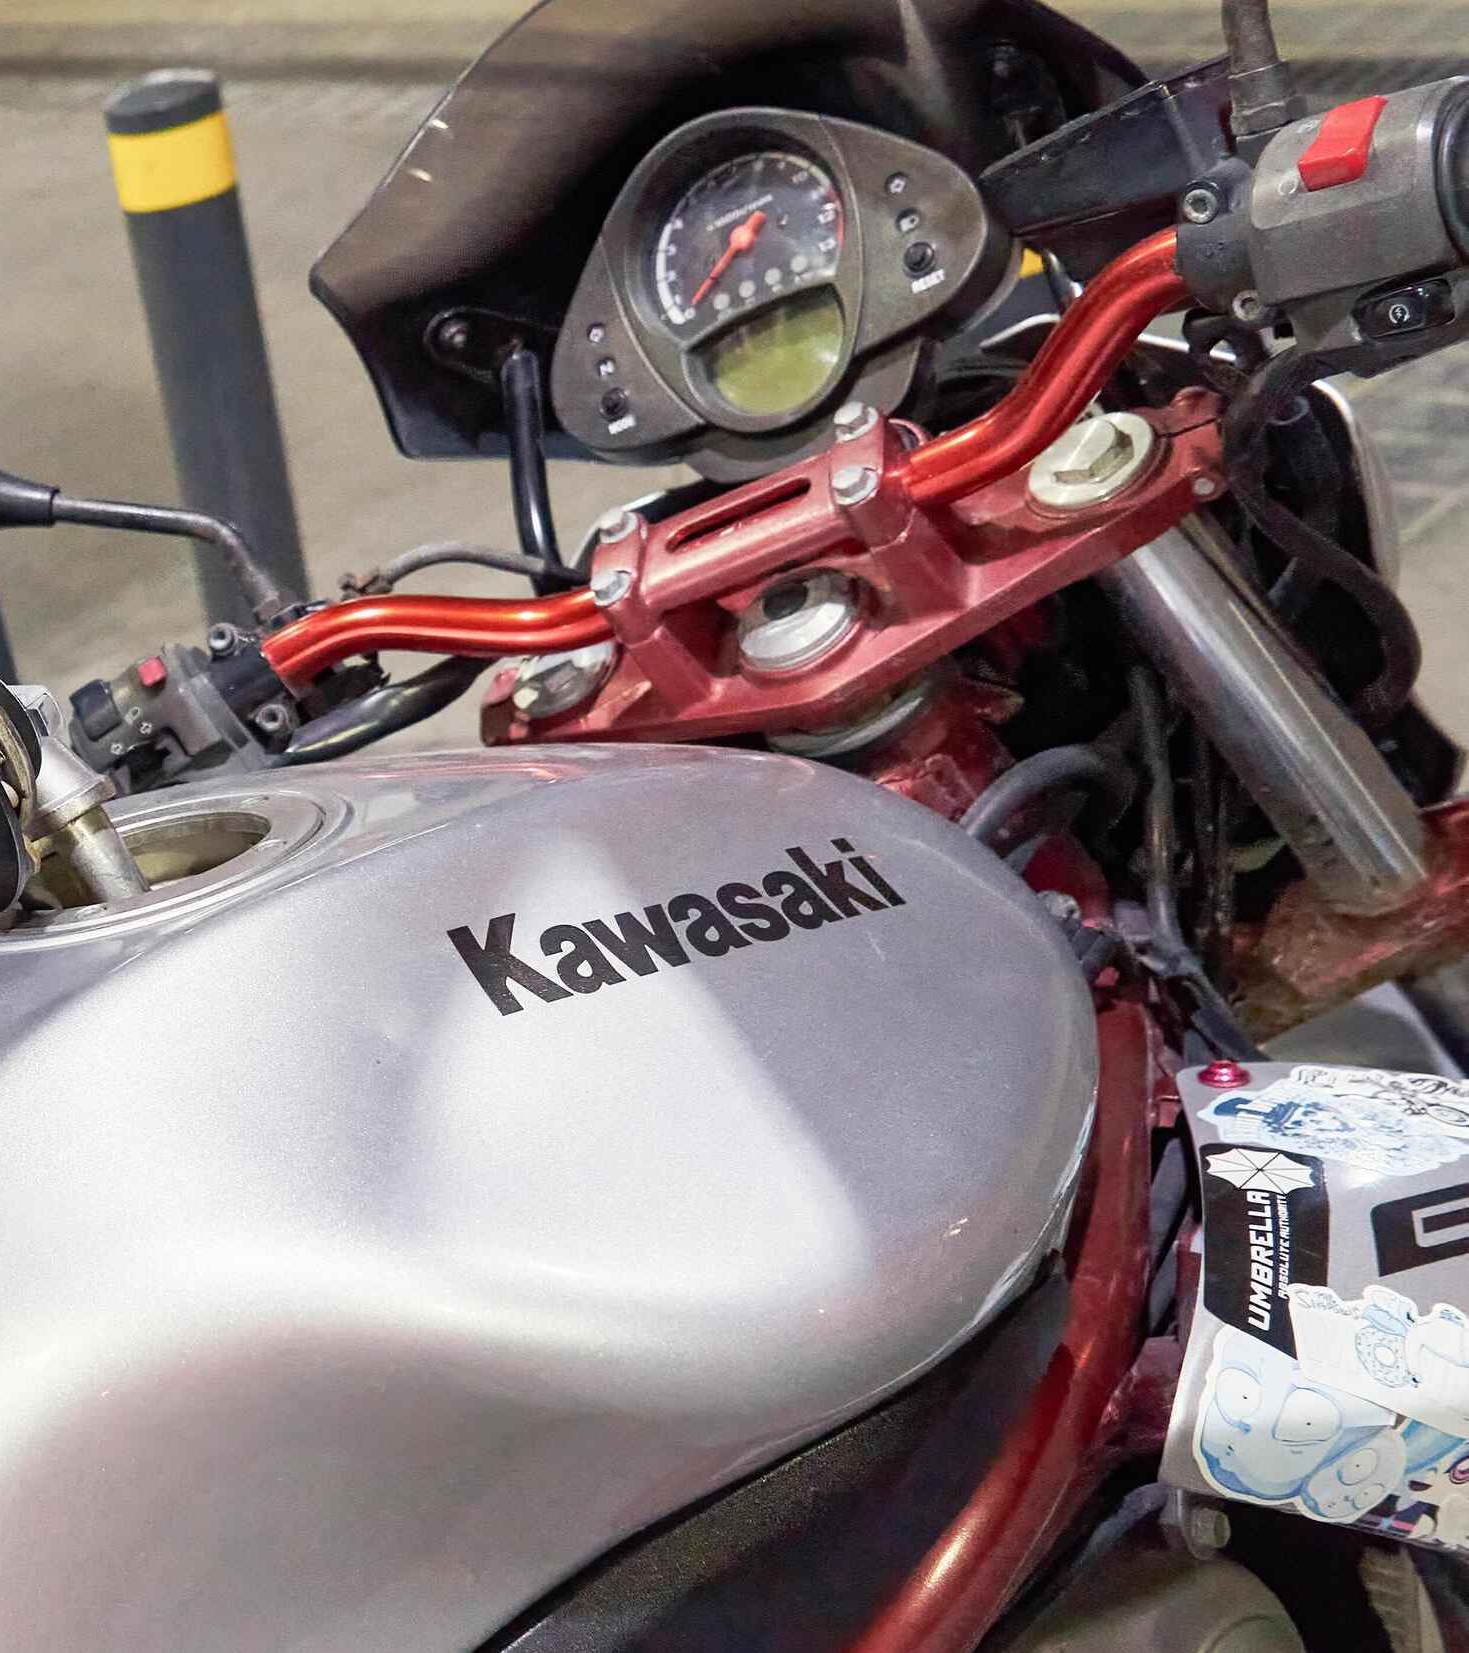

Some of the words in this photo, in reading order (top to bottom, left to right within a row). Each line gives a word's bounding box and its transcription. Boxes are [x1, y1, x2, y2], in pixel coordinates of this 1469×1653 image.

[446, 837, 907, 1017] Kawasaki
[1246, 1190, 1274, 1331] UMBRELLA
[1277, 1239, 1290, 1299] ABSOLUTE
